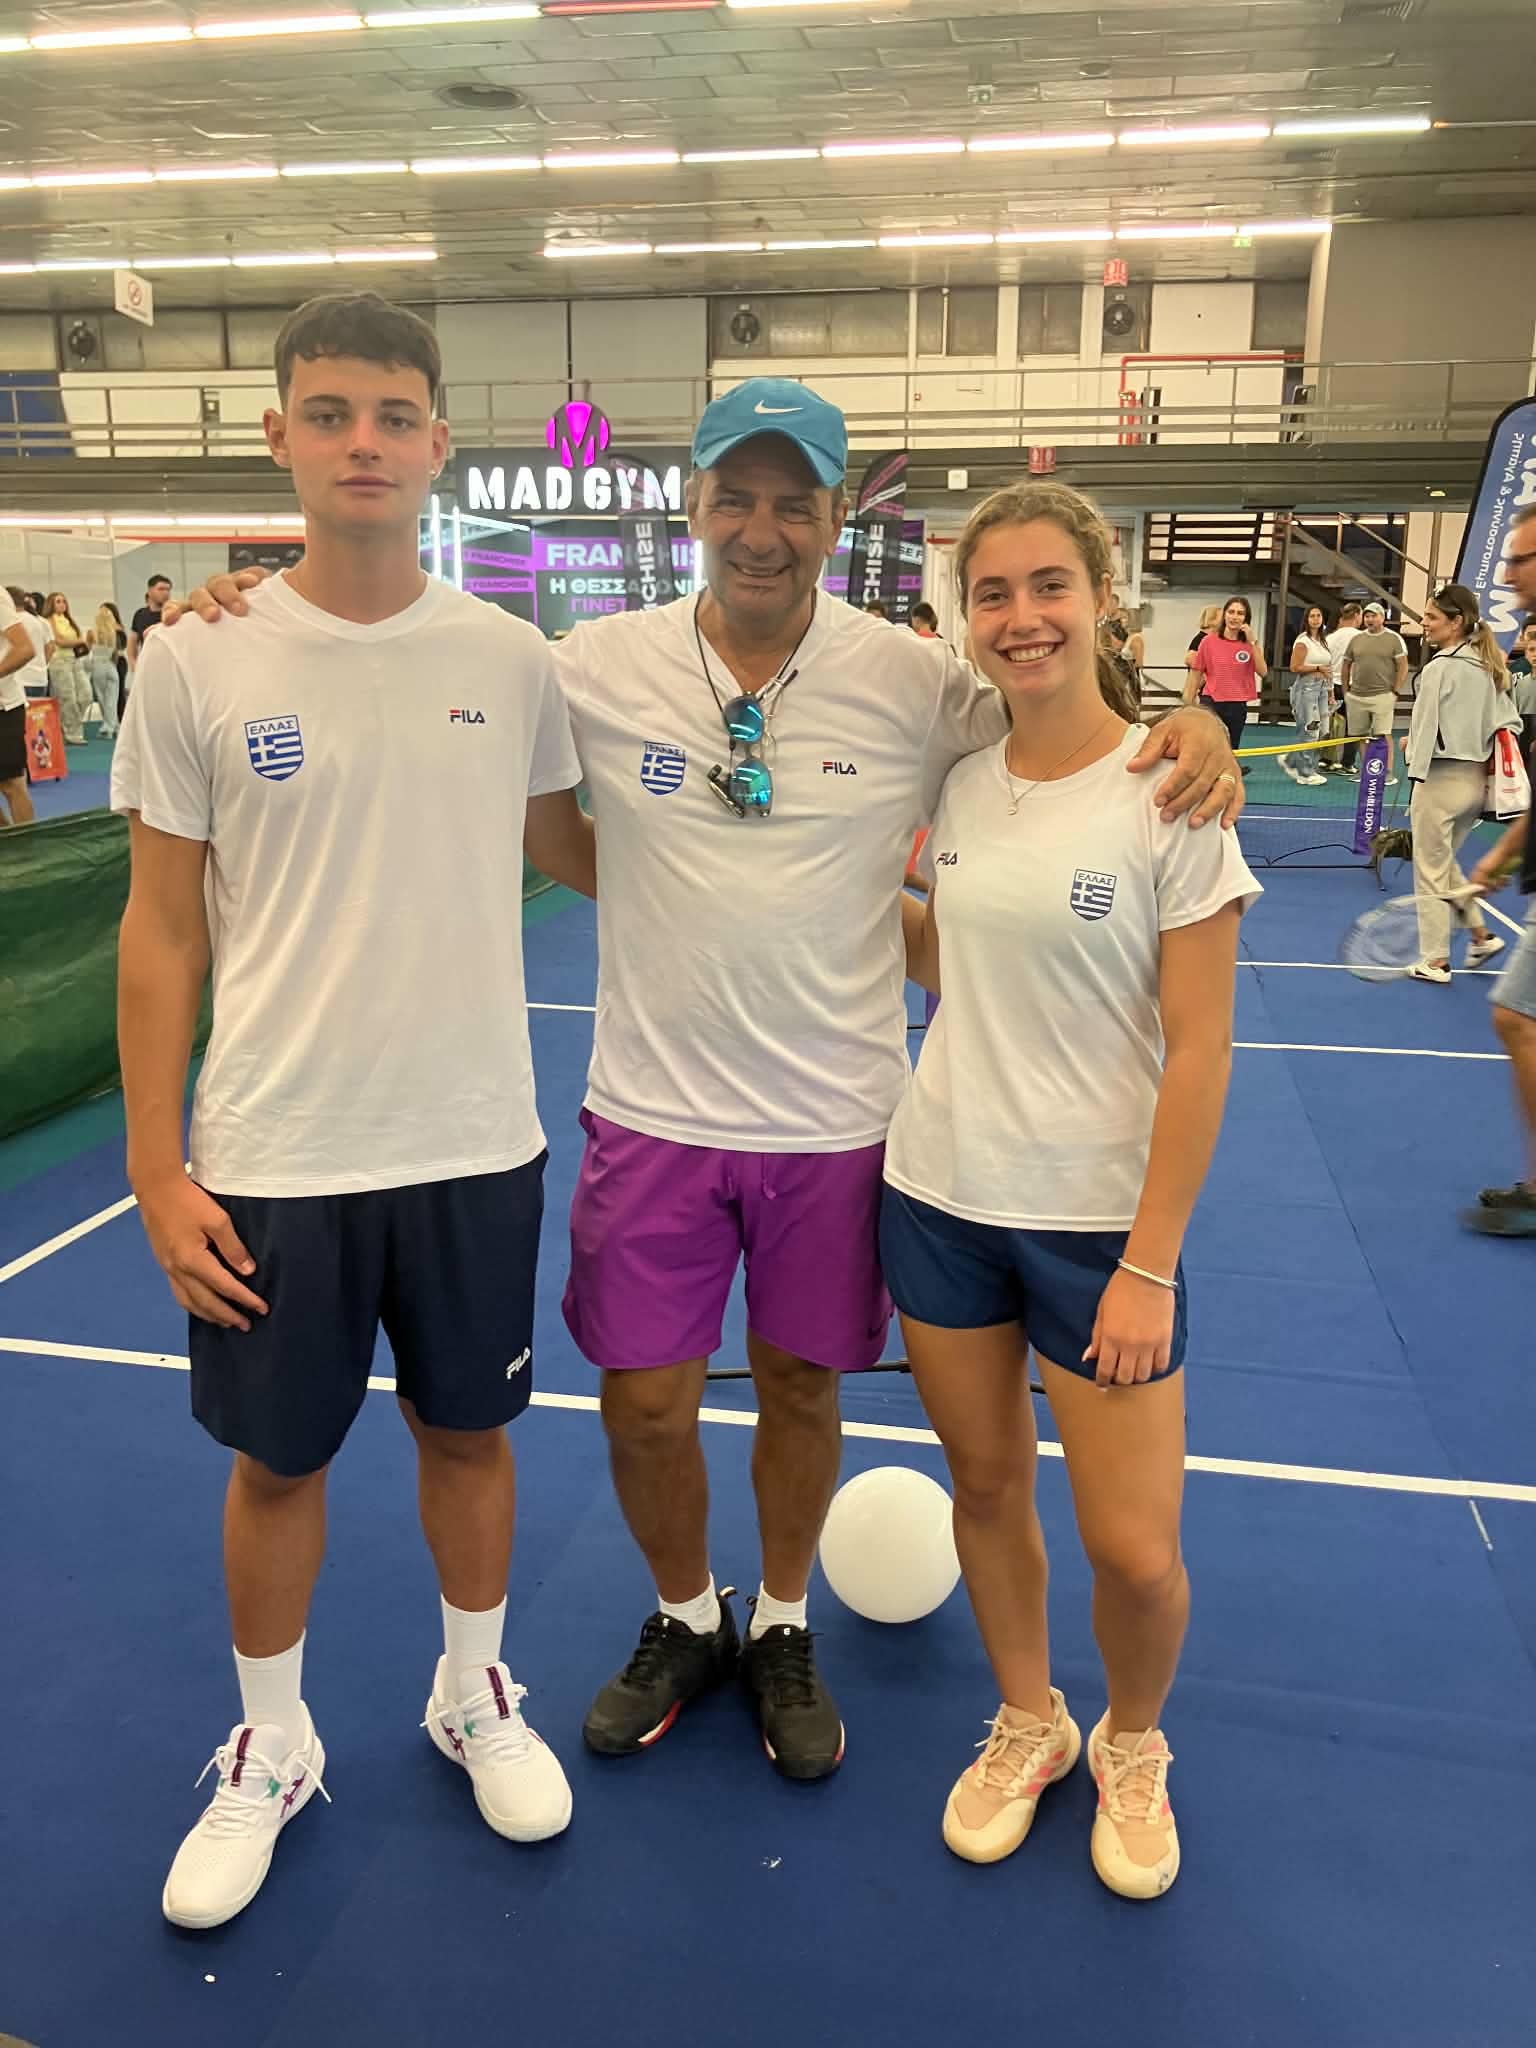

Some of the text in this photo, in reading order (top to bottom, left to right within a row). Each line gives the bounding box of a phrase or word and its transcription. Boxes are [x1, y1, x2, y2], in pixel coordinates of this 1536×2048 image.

[468, 466, 681, 510] MAD GYM
[449, 709, 486, 725] FILA
[249, 720, 296, 736] ΕΛΛΑΣ
[822, 761, 857, 775] FILA
[1364, 778, 1378, 834] WIMBLEDON
[1077, 872, 1113, 886] ΕΛΛΑΣ
[506, 1346, 531, 1380] FILA
